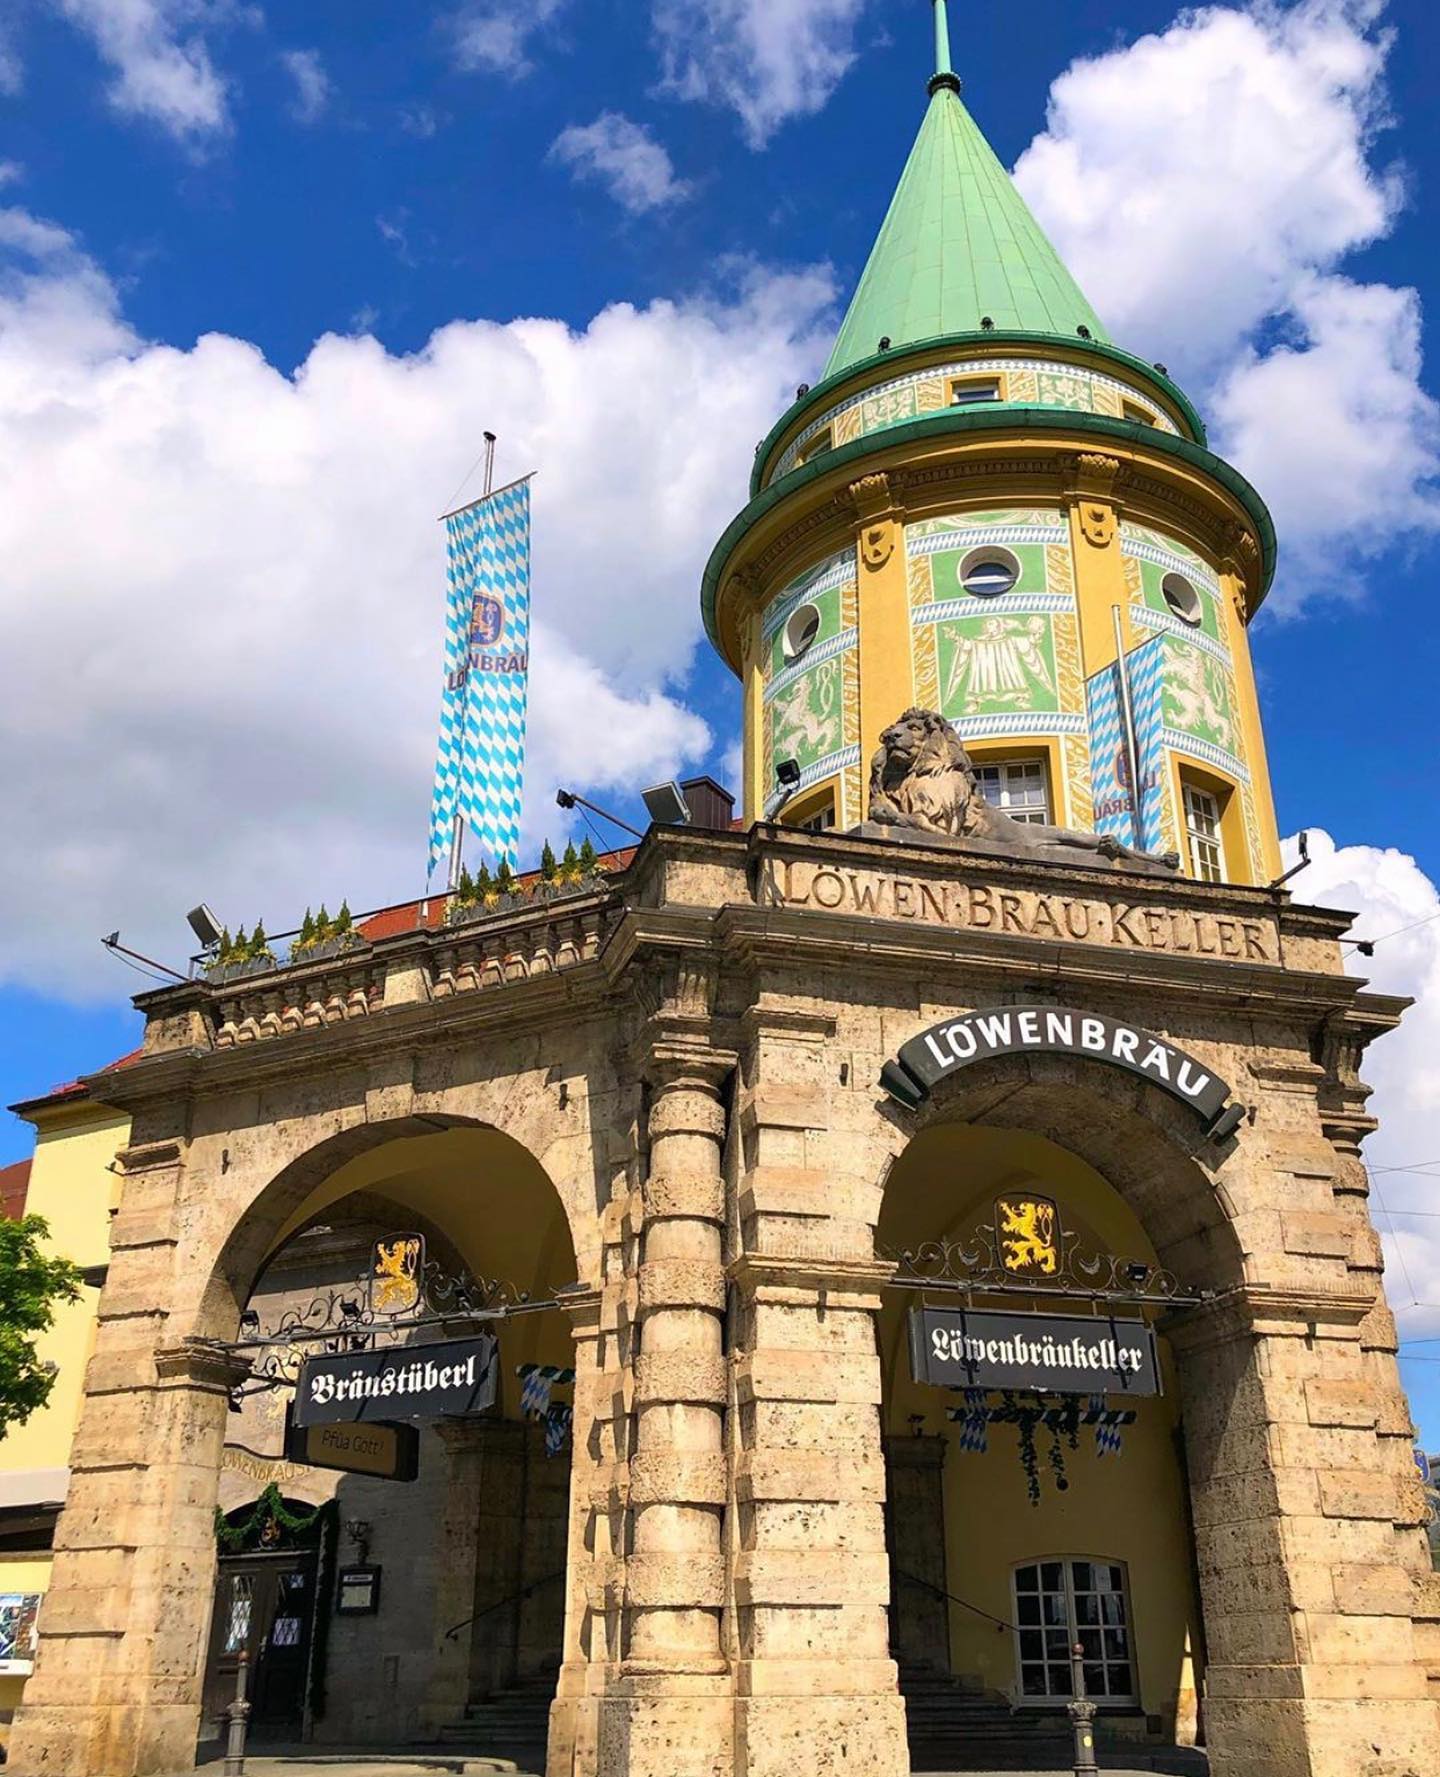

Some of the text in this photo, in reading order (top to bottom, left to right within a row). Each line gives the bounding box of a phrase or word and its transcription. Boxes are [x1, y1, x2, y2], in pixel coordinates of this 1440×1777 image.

[924, 1011, 1210, 1097] LÖWENBRÄU
[931, 1327, 1142, 1371] Löwenbräukeller
[311, 1355, 476, 1404] Bräustüberl
